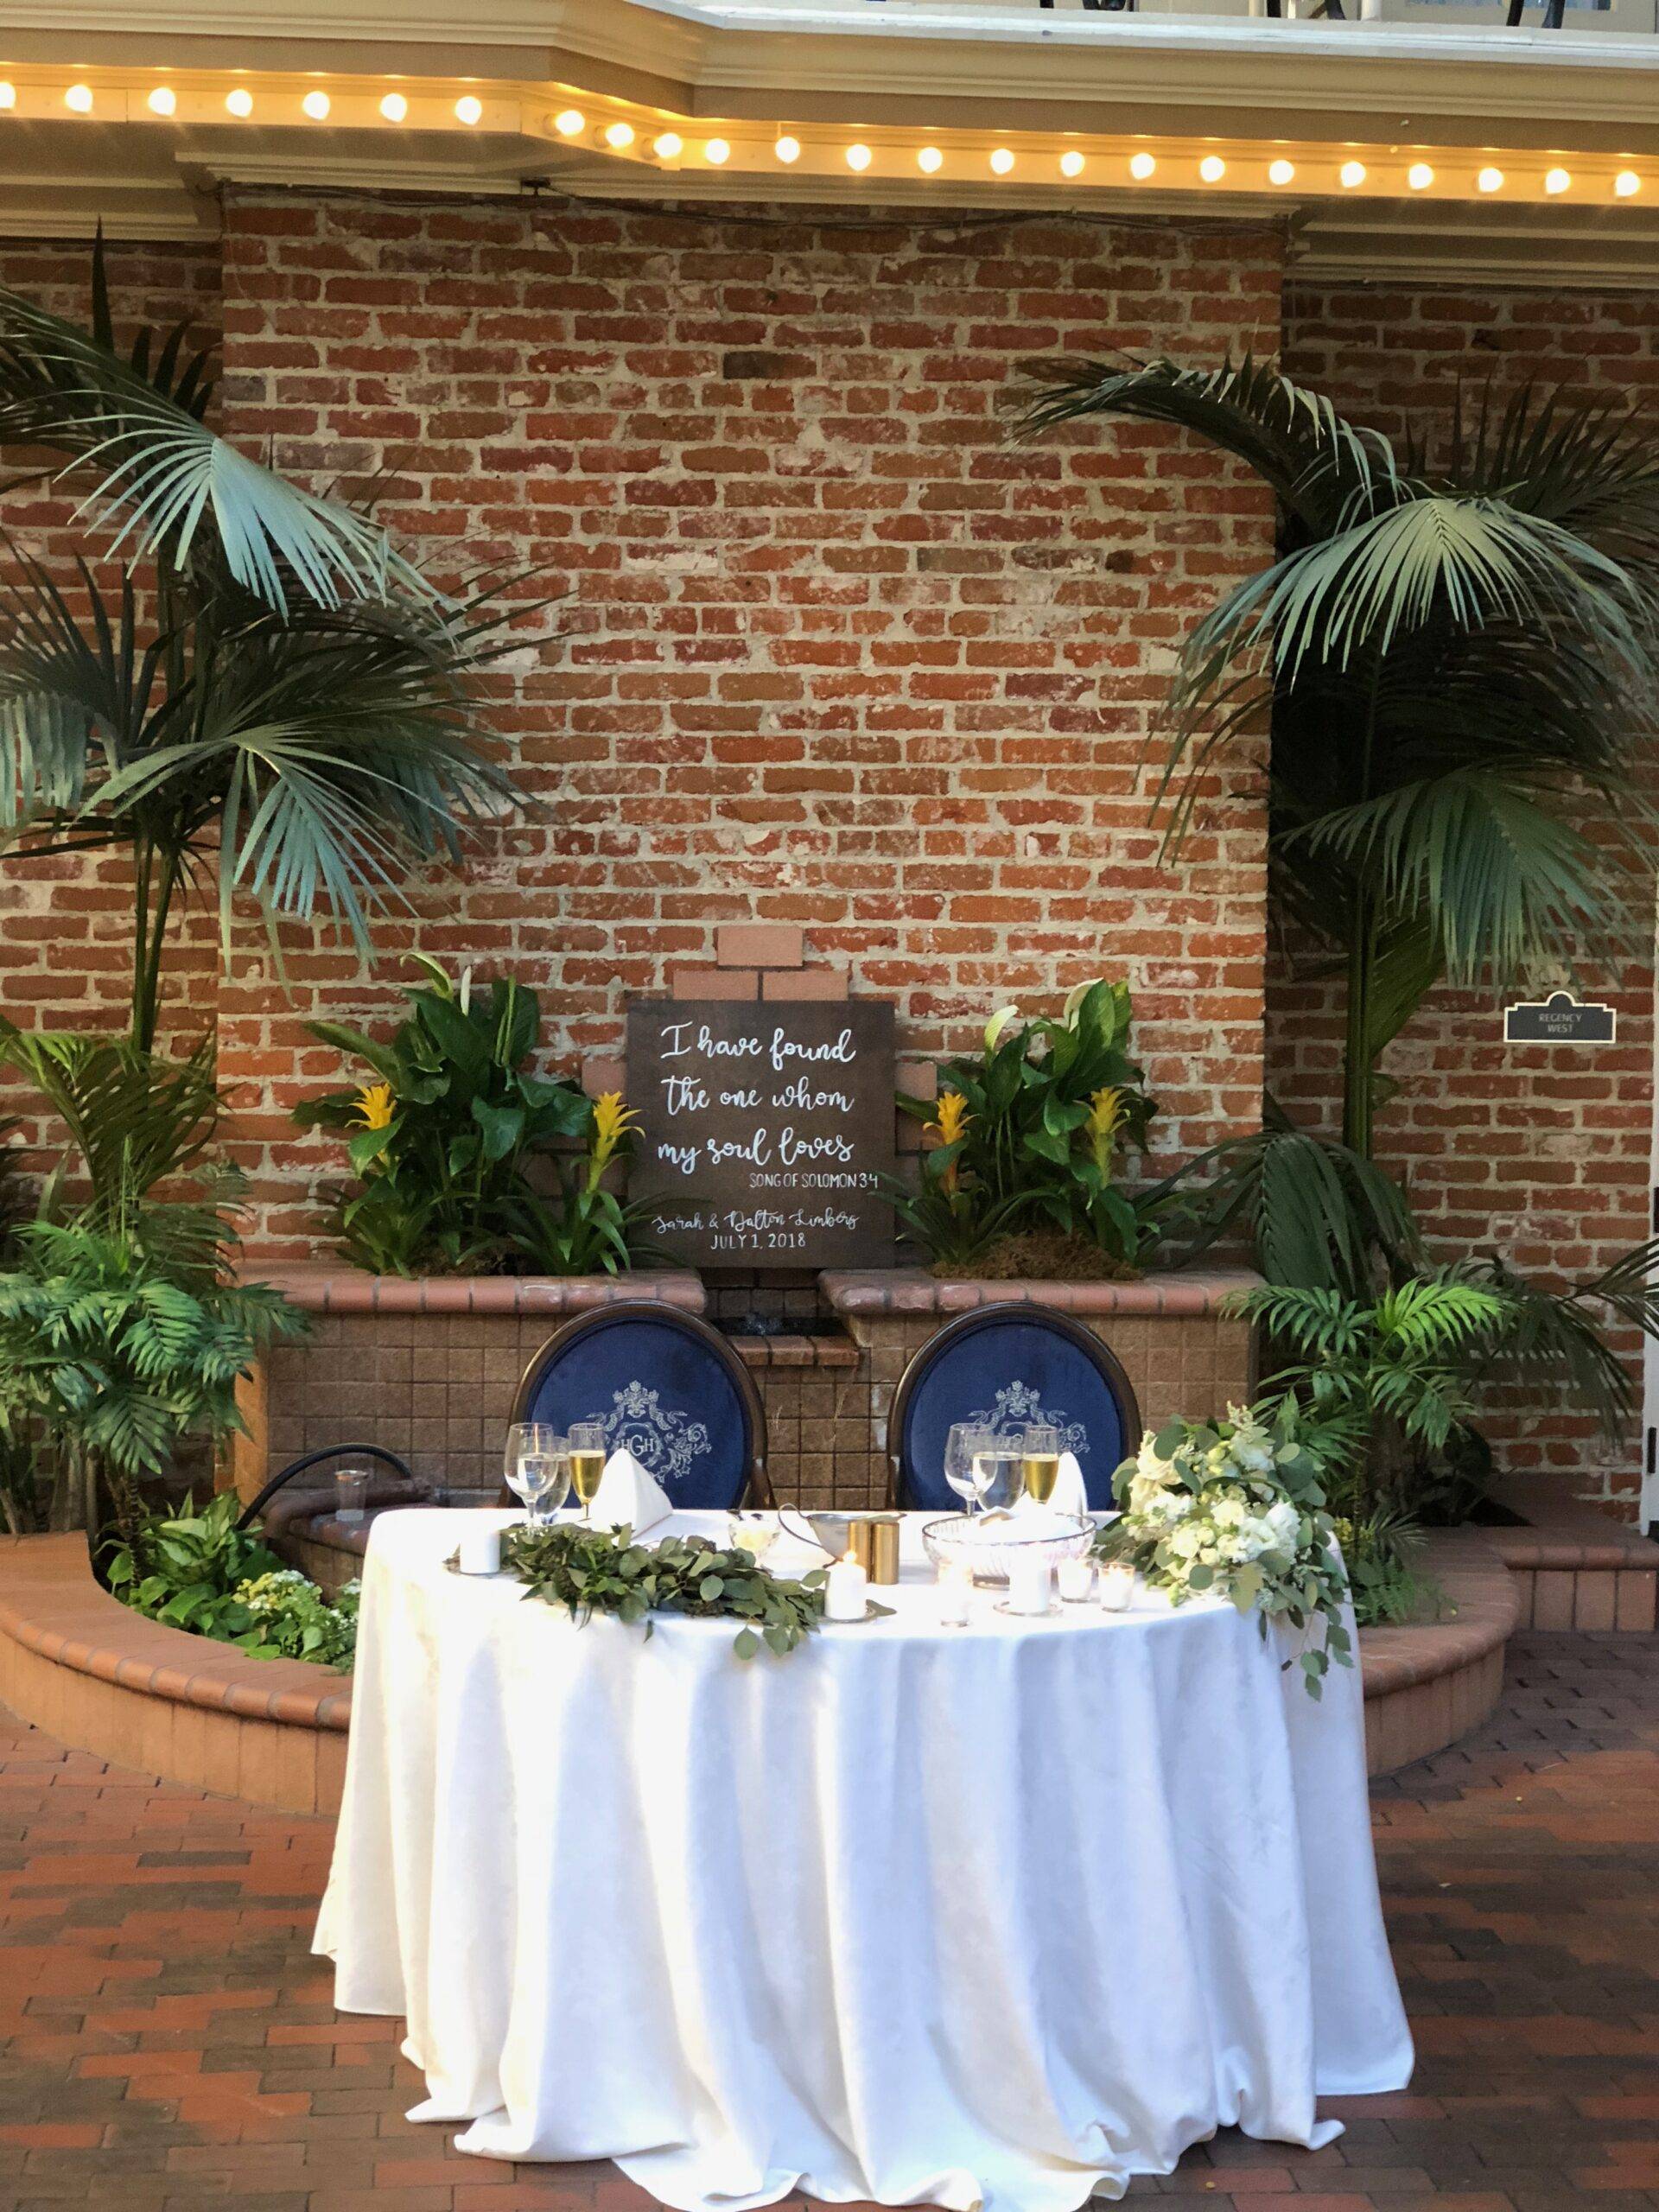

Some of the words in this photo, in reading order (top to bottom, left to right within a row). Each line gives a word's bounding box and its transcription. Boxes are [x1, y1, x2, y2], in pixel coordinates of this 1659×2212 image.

[1548, 1024, 1573, 1033] WEST
[660, 1020, 693, 1059] I
[696, 1025, 763, 1058] have
[769, 1027, 856, 1071] found
[719, 1090, 762, 1113] one
[772, 1076, 855, 1113] whom
[658, 1141, 702, 1174] my
[706, 1128, 772, 1166] soul
[779, 1127, 855, 1166] loves
[748, 1173, 781, 1188] SONG
[784, 1173, 799, 1187] OF
[801, 1173, 858, 1188] SOLOMON
[652, 1212, 704, 1234] Sarah
[709, 1212, 720, 1230] &
[723, 1209, 785, 1231] Dalton
[710, 1234, 747, 1250] JULY
[767, 1232, 807, 1248] 2018
